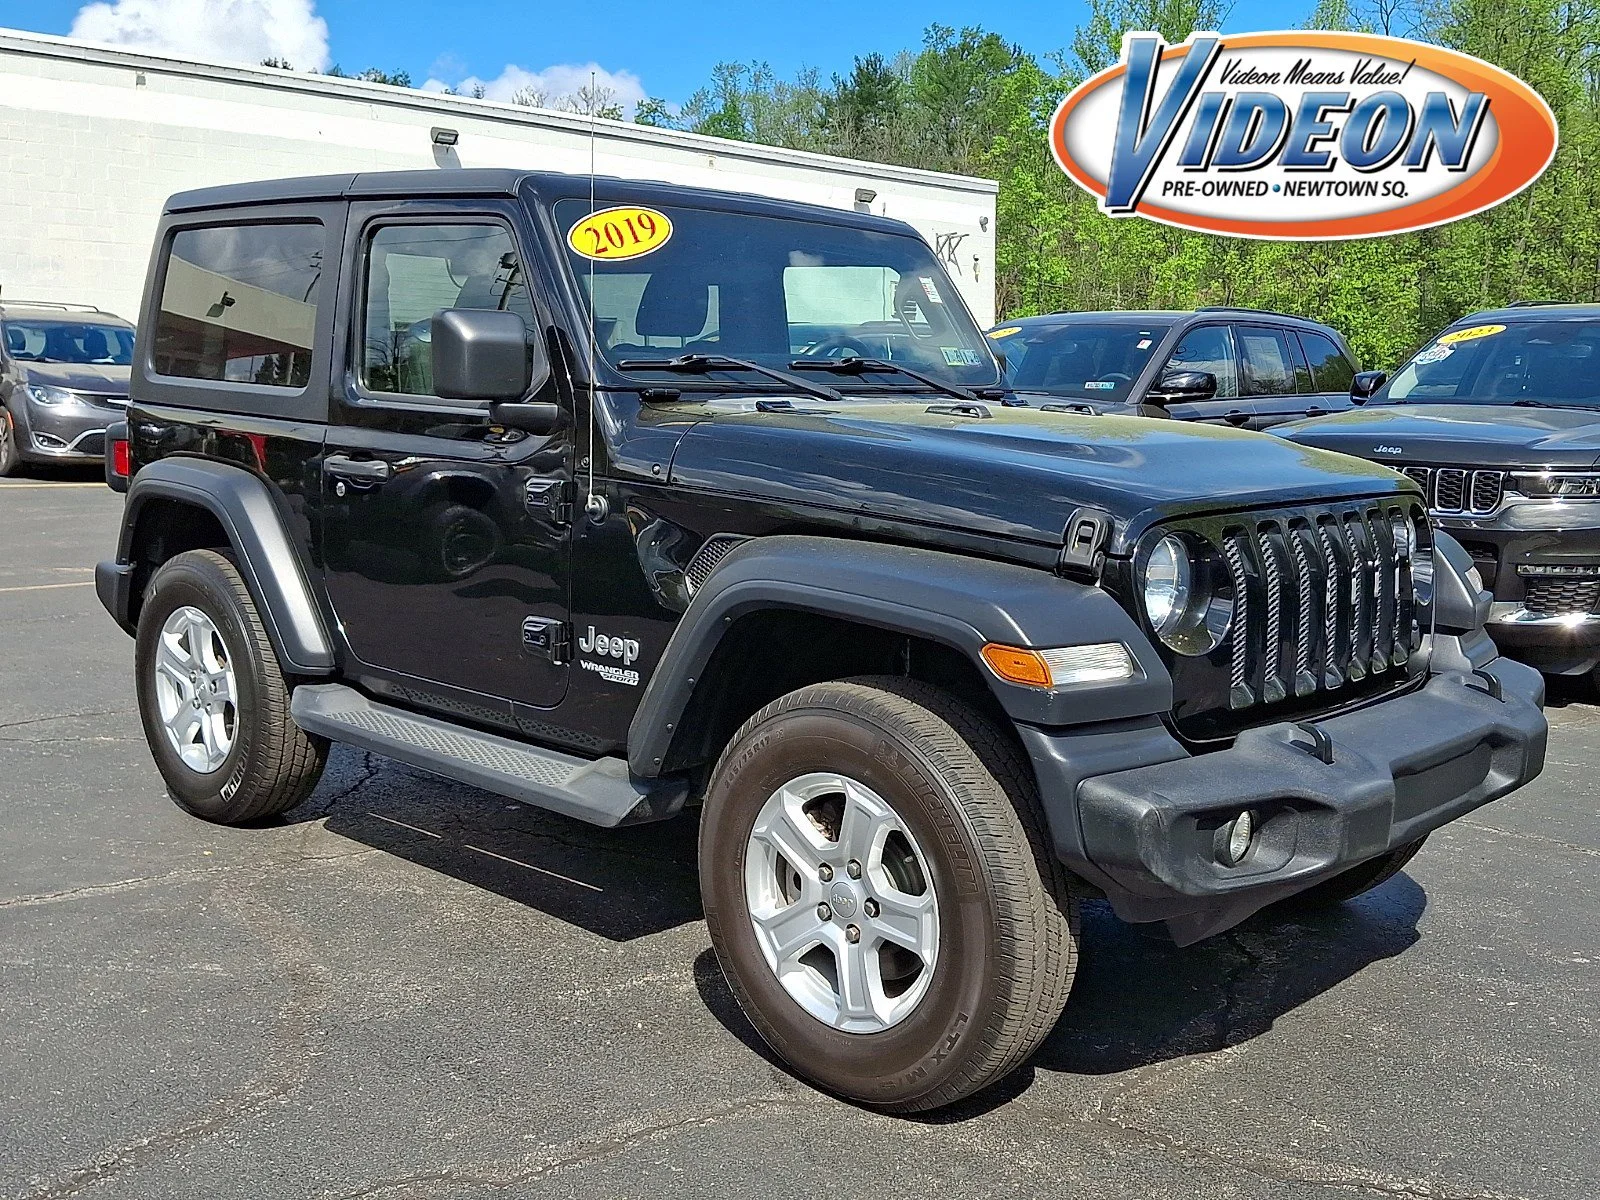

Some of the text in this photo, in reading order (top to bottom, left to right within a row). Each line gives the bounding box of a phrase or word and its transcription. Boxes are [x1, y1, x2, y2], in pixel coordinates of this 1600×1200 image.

[584, 212, 657, 255] 2019
[1373, 444, 1402, 455] Jeep
[578, 625, 640, 666] Jeep
[580, 660, 639, 680] WRANGLER
[602, 672, 638, 685] SPORT
[900, 763, 979, 895] MICHELIN
[930, 1011, 969, 1067] LTX
